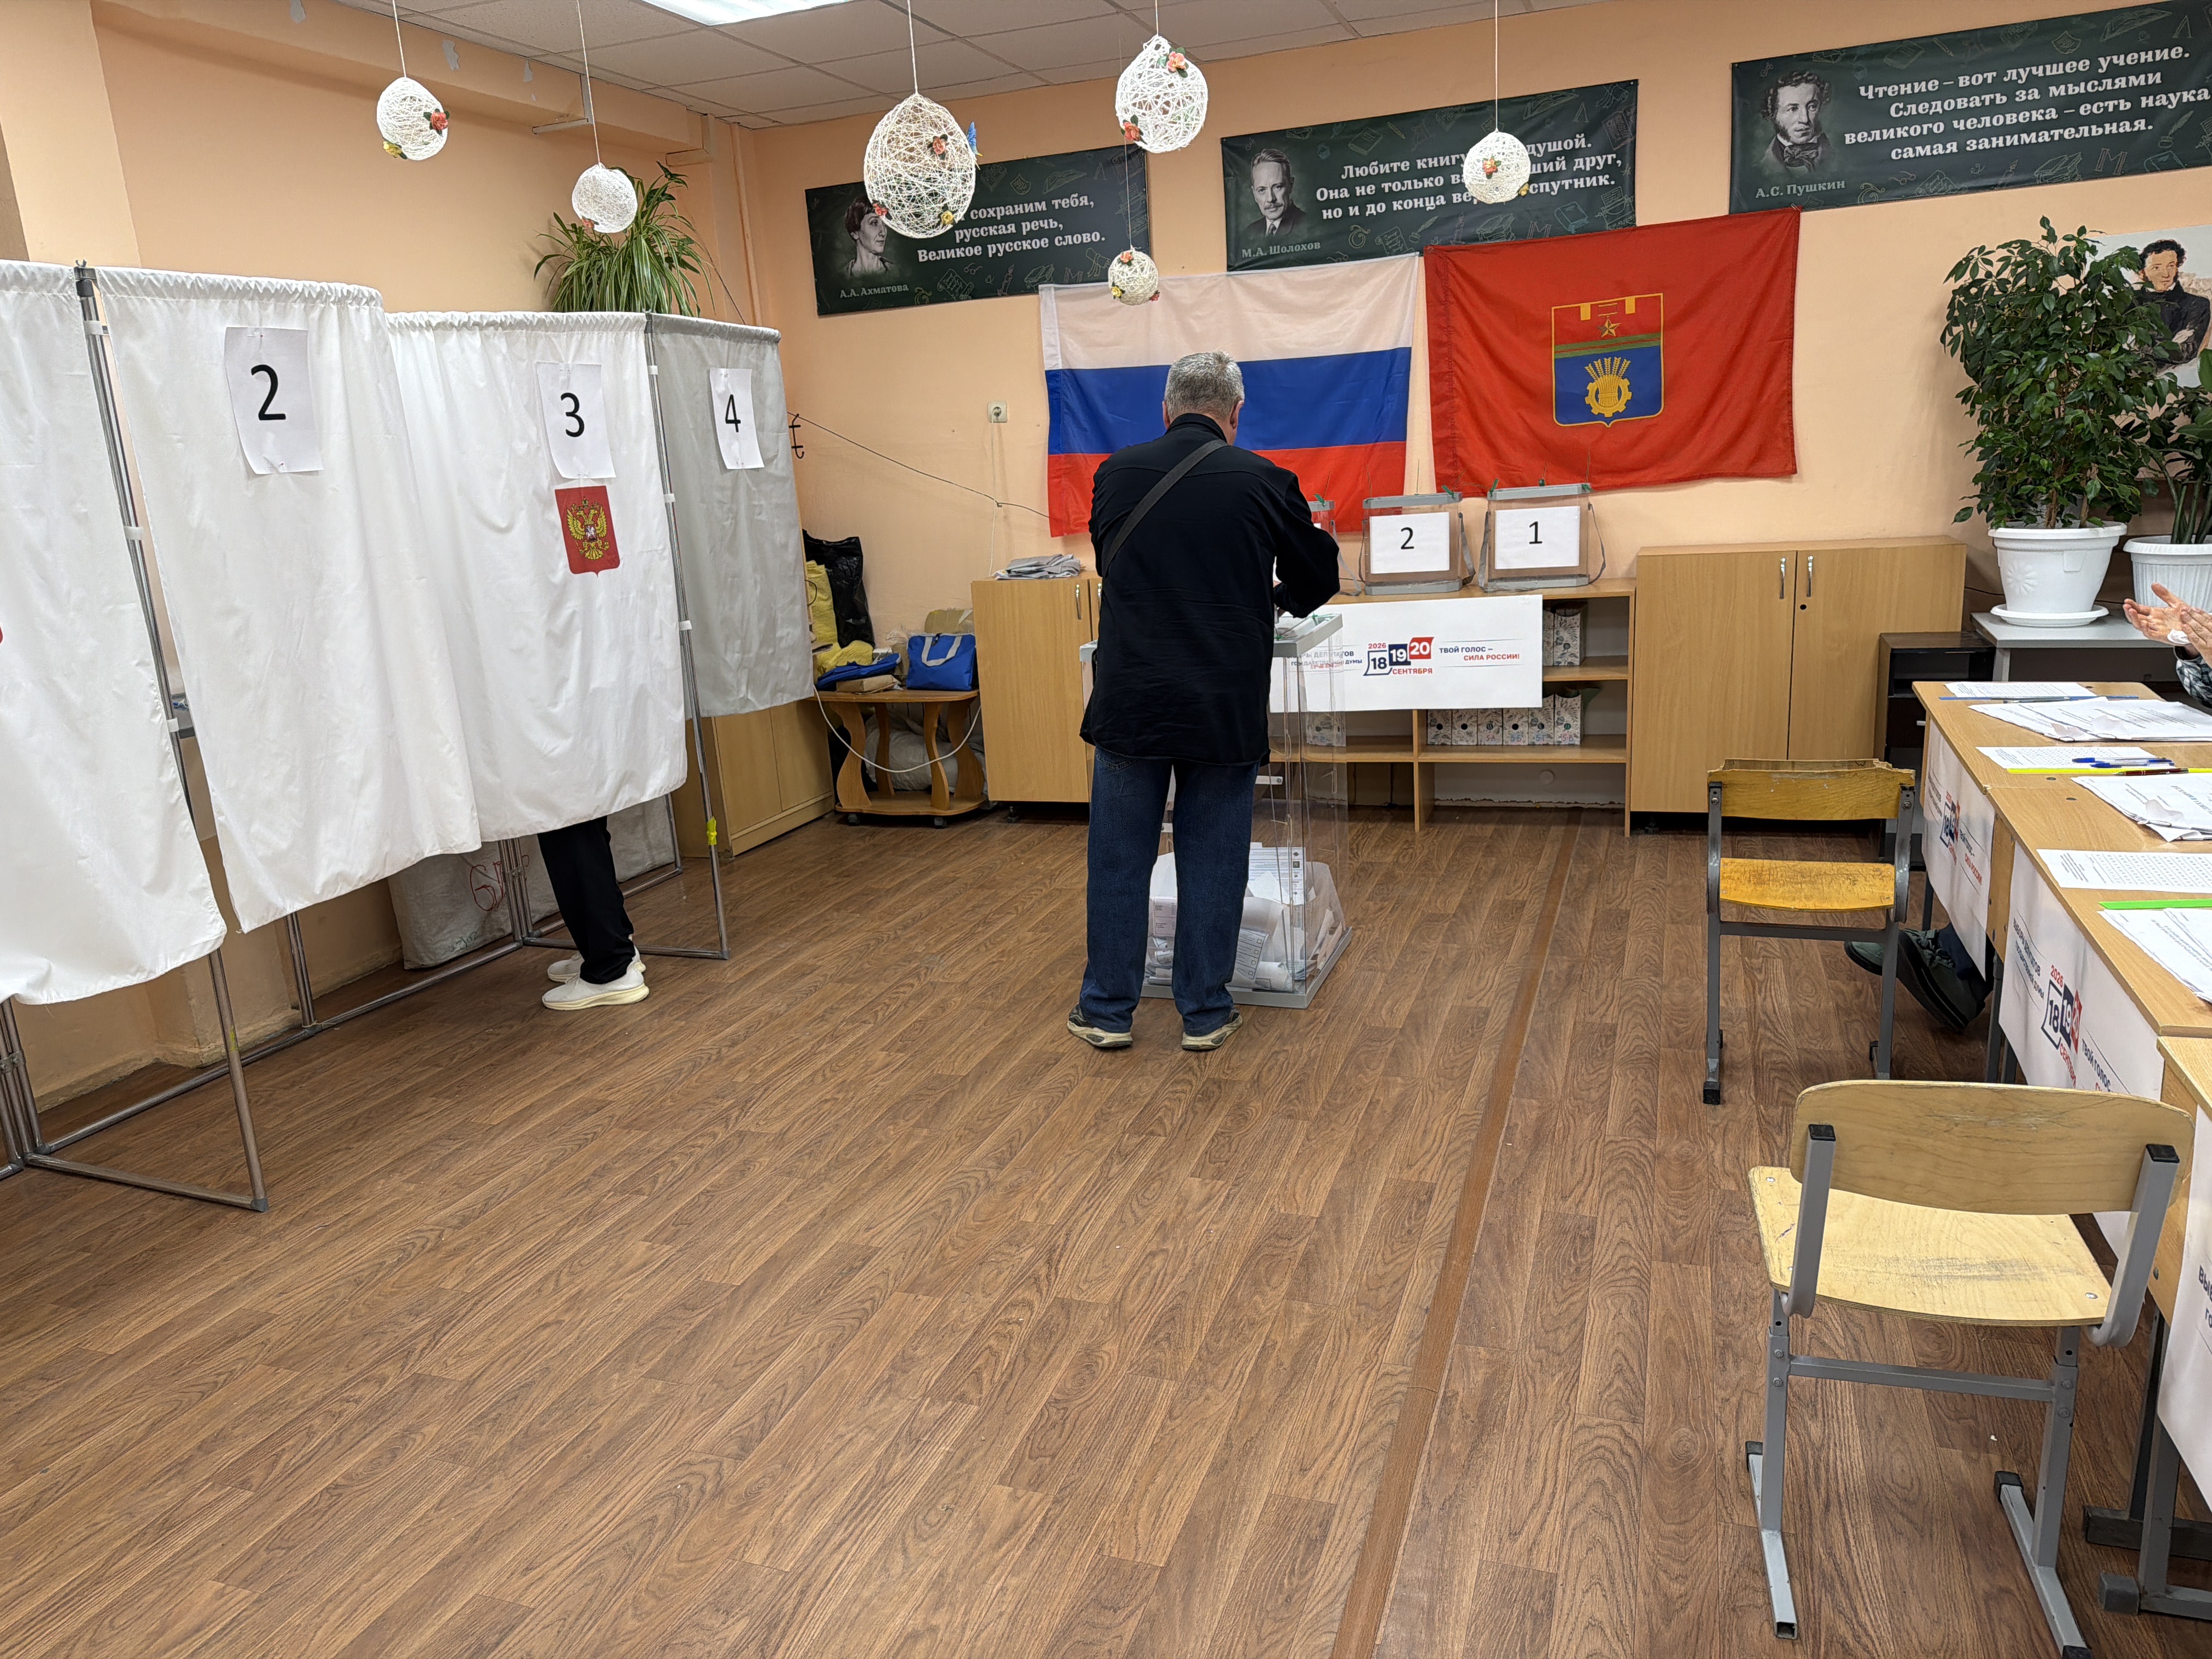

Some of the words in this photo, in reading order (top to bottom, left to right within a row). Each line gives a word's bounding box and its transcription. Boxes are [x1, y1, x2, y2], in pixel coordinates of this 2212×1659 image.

[1859, 79, 1939, 99] Чтение
[1957, 71, 1997, 87] вот
[2003, 59, 2090, 83] лучшее
[2097, 46, 2190, 73] учение.
[1890, 93, 2007, 117] Следовать
[2015, 87, 2041, 102] за
[2049, 72, 2162, 98] мыслями
[1844, 121, 1945, 145] великого
[1953, 107, 2058, 131] человека
[2079, 99, 2132, 116] есть
[2140, 88, 2211, 109] наука
[1341, 160, 1410, 179] Любите
[1526, 133, 1592, 157] душой.
[1891, 141, 1958, 160] самая
[1966, 119, 2153, 151] занимательная.
[1316, 187, 1350, 201] Она
[1355, 184, 1376, 196] не
[1381, 175, 1444, 193] только
[1573, 153, 1622, 171] друг,
[1322, 207, 1342, 219] но
[1348, 206, 1359, 216] и
[1365, 204, 1386, 217] до
[1392, 194, 1446, 211] конца
[1529, 174, 1615, 195] спутник.
[1756, 186, 1784, 199] А.С.
[1787, 180, 1846, 196] Пушкин
[970, 200, 1047, 221] сохраним
[1052, 193, 1094, 210] тебя,
[917, 245, 982, 262] Великое
[987, 237, 1049, 257] русское
[1054, 231, 1105, 246] слово.
[955, 223, 1016, 243] русская
[1021, 218, 1063, 235] речь,
[1242, 247, 1267, 258] М.А.
[1269, 242, 1321, 255] Шолохов
[250, 364, 287, 421] 2
[560, 392, 585, 438] 3
[724, 393, 742, 433] 4
[1400, 526, 1415, 550] 2
[1528, 521, 1543, 545] 1
[1371, 657, 1387, 669] 18
[1390, 648, 1407, 662] 19
[1410, 641, 1430, 655] 20
[2050, 964, 2063, 988] 2026
[2049, 999, 2059, 1033] 18
[2062, 999, 2072, 1034] 19
[2082, 1038, 2094, 1067] ТВОЙ
[2094, 1060, 2111, 1092] ГОЛОС
